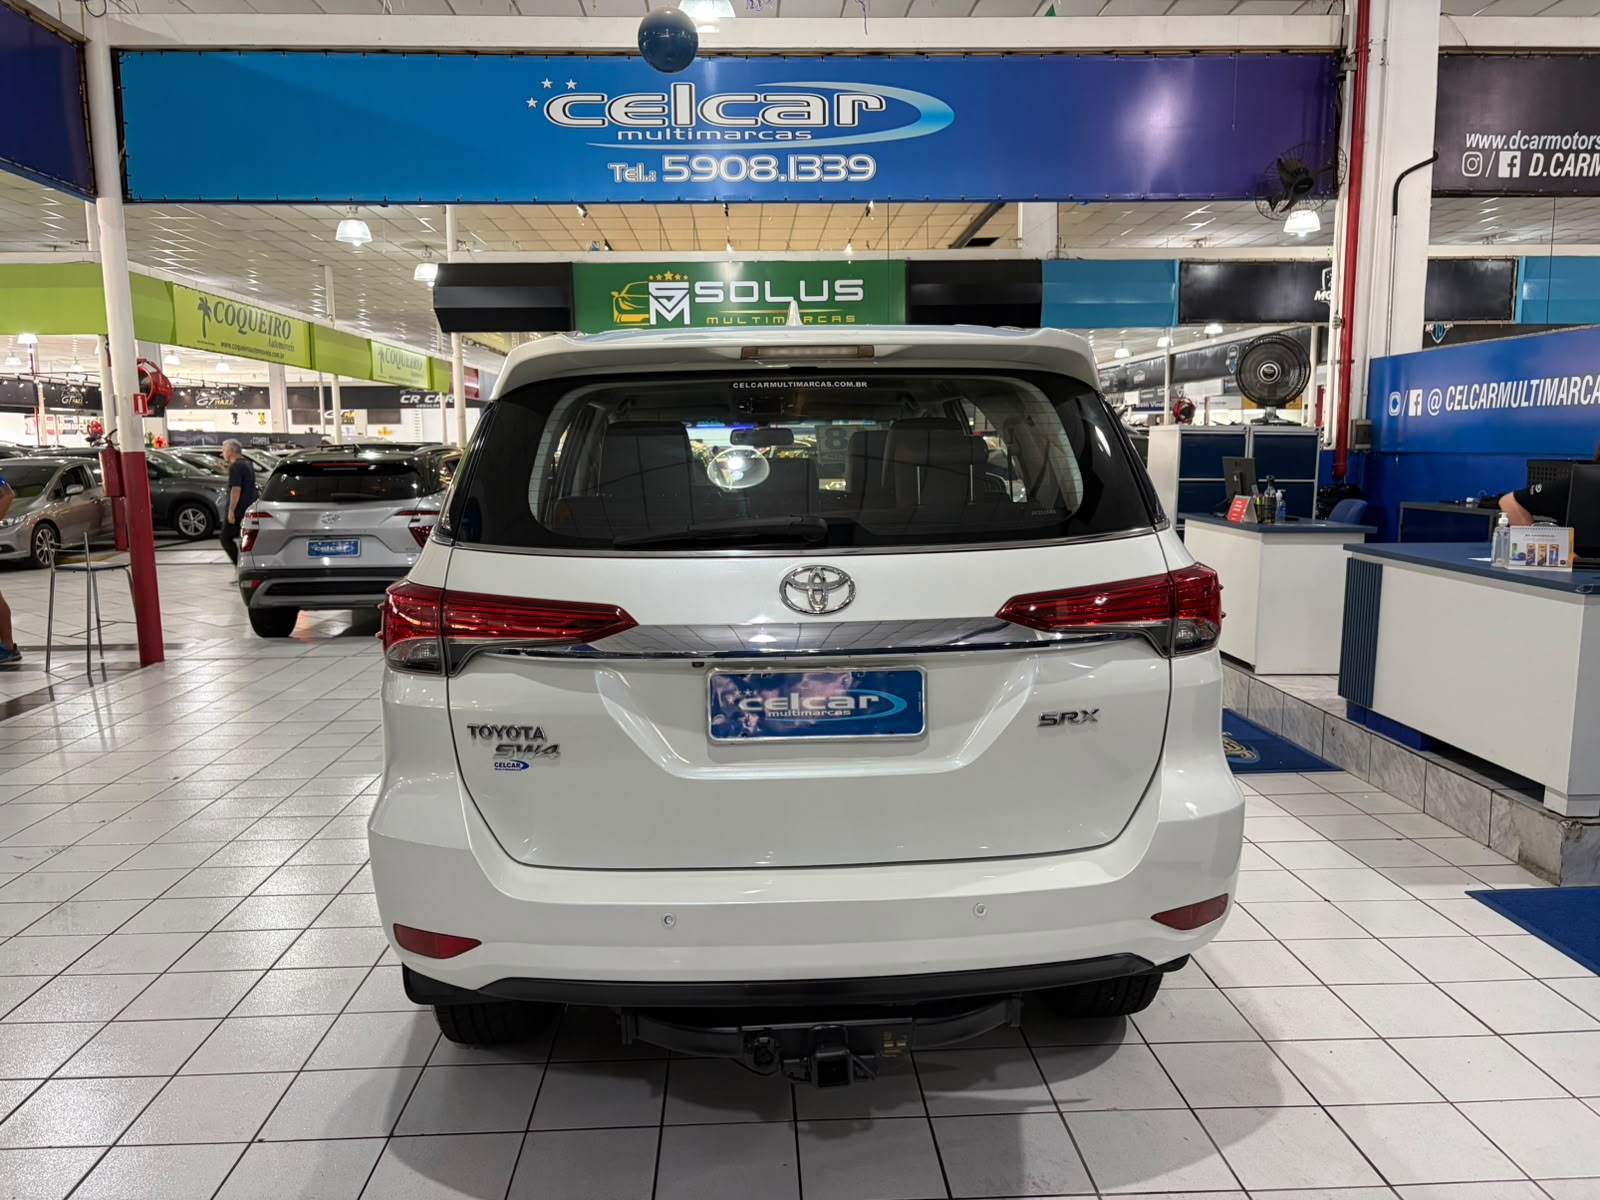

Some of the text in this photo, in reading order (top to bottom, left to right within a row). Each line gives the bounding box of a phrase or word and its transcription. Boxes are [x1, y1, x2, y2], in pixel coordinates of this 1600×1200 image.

[544, 82, 886, 128] celcar
[617, 127, 813, 142] multimarcas
[1465, 130, 1600, 151] www.dcarmotors
[662, 154, 877, 183] 5908.1339
[694, 279, 865, 303] SOLUS
[213, 301, 292, 340] COQUEIRO
[706, 314, 857, 325] MULTIMRCAS
[385, 348, 423, 370] COQUEIRO
[732, 381, 868, 389] CELCARMULTIMARCAS.COM.BR
[400, 394, 421, 404] CR
[738, 692, 879, 711] celcar
[767, 707, 852, 718] multimarcas
[1037, 708, 1100, 728] SRX
[466, 723, 548, 742] TOYOTA
[492, 743, 561, 760] SW4
